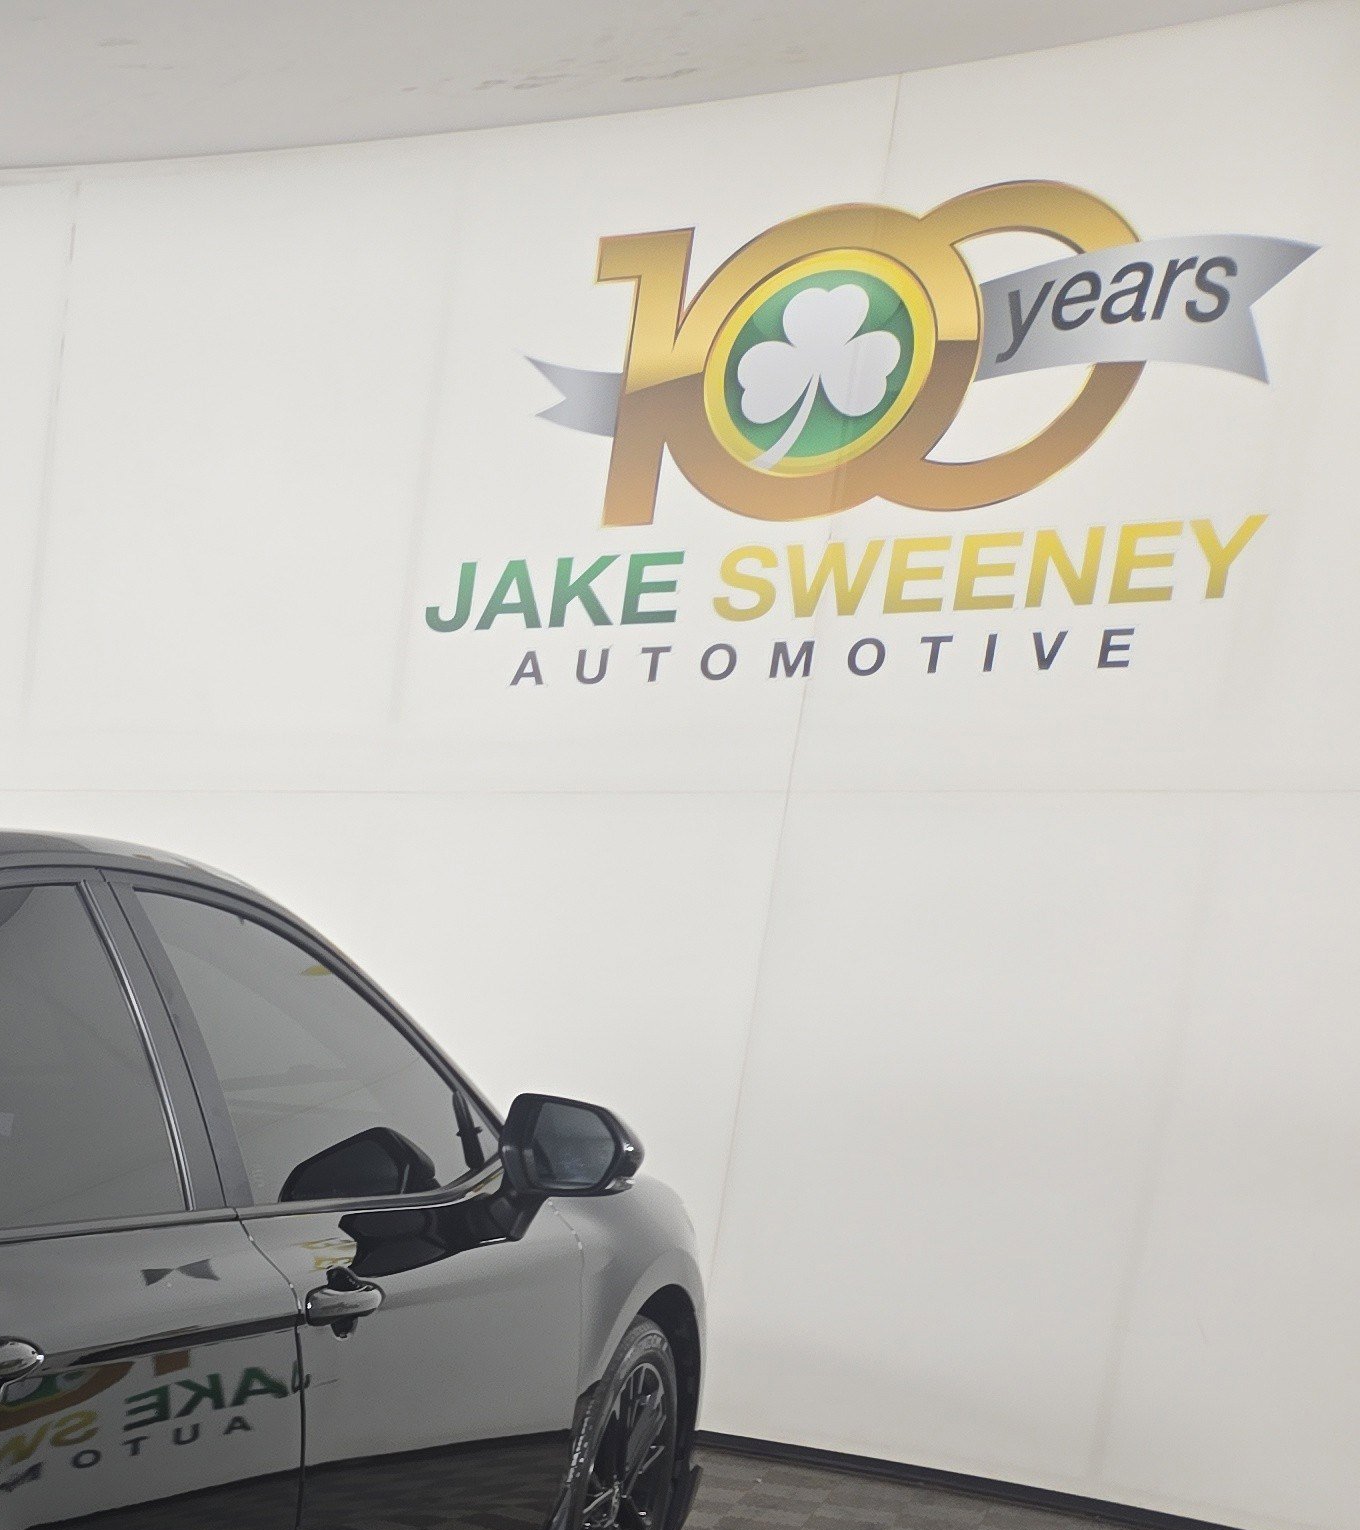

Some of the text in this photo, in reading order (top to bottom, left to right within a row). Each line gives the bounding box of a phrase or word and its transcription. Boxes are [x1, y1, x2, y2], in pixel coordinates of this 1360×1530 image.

[995, 251, 1238, 364] years
[424, 513, 1270, 633] JAKE SWEENEY
[509, 626, 1137, 688] AUTOMOTIVE
